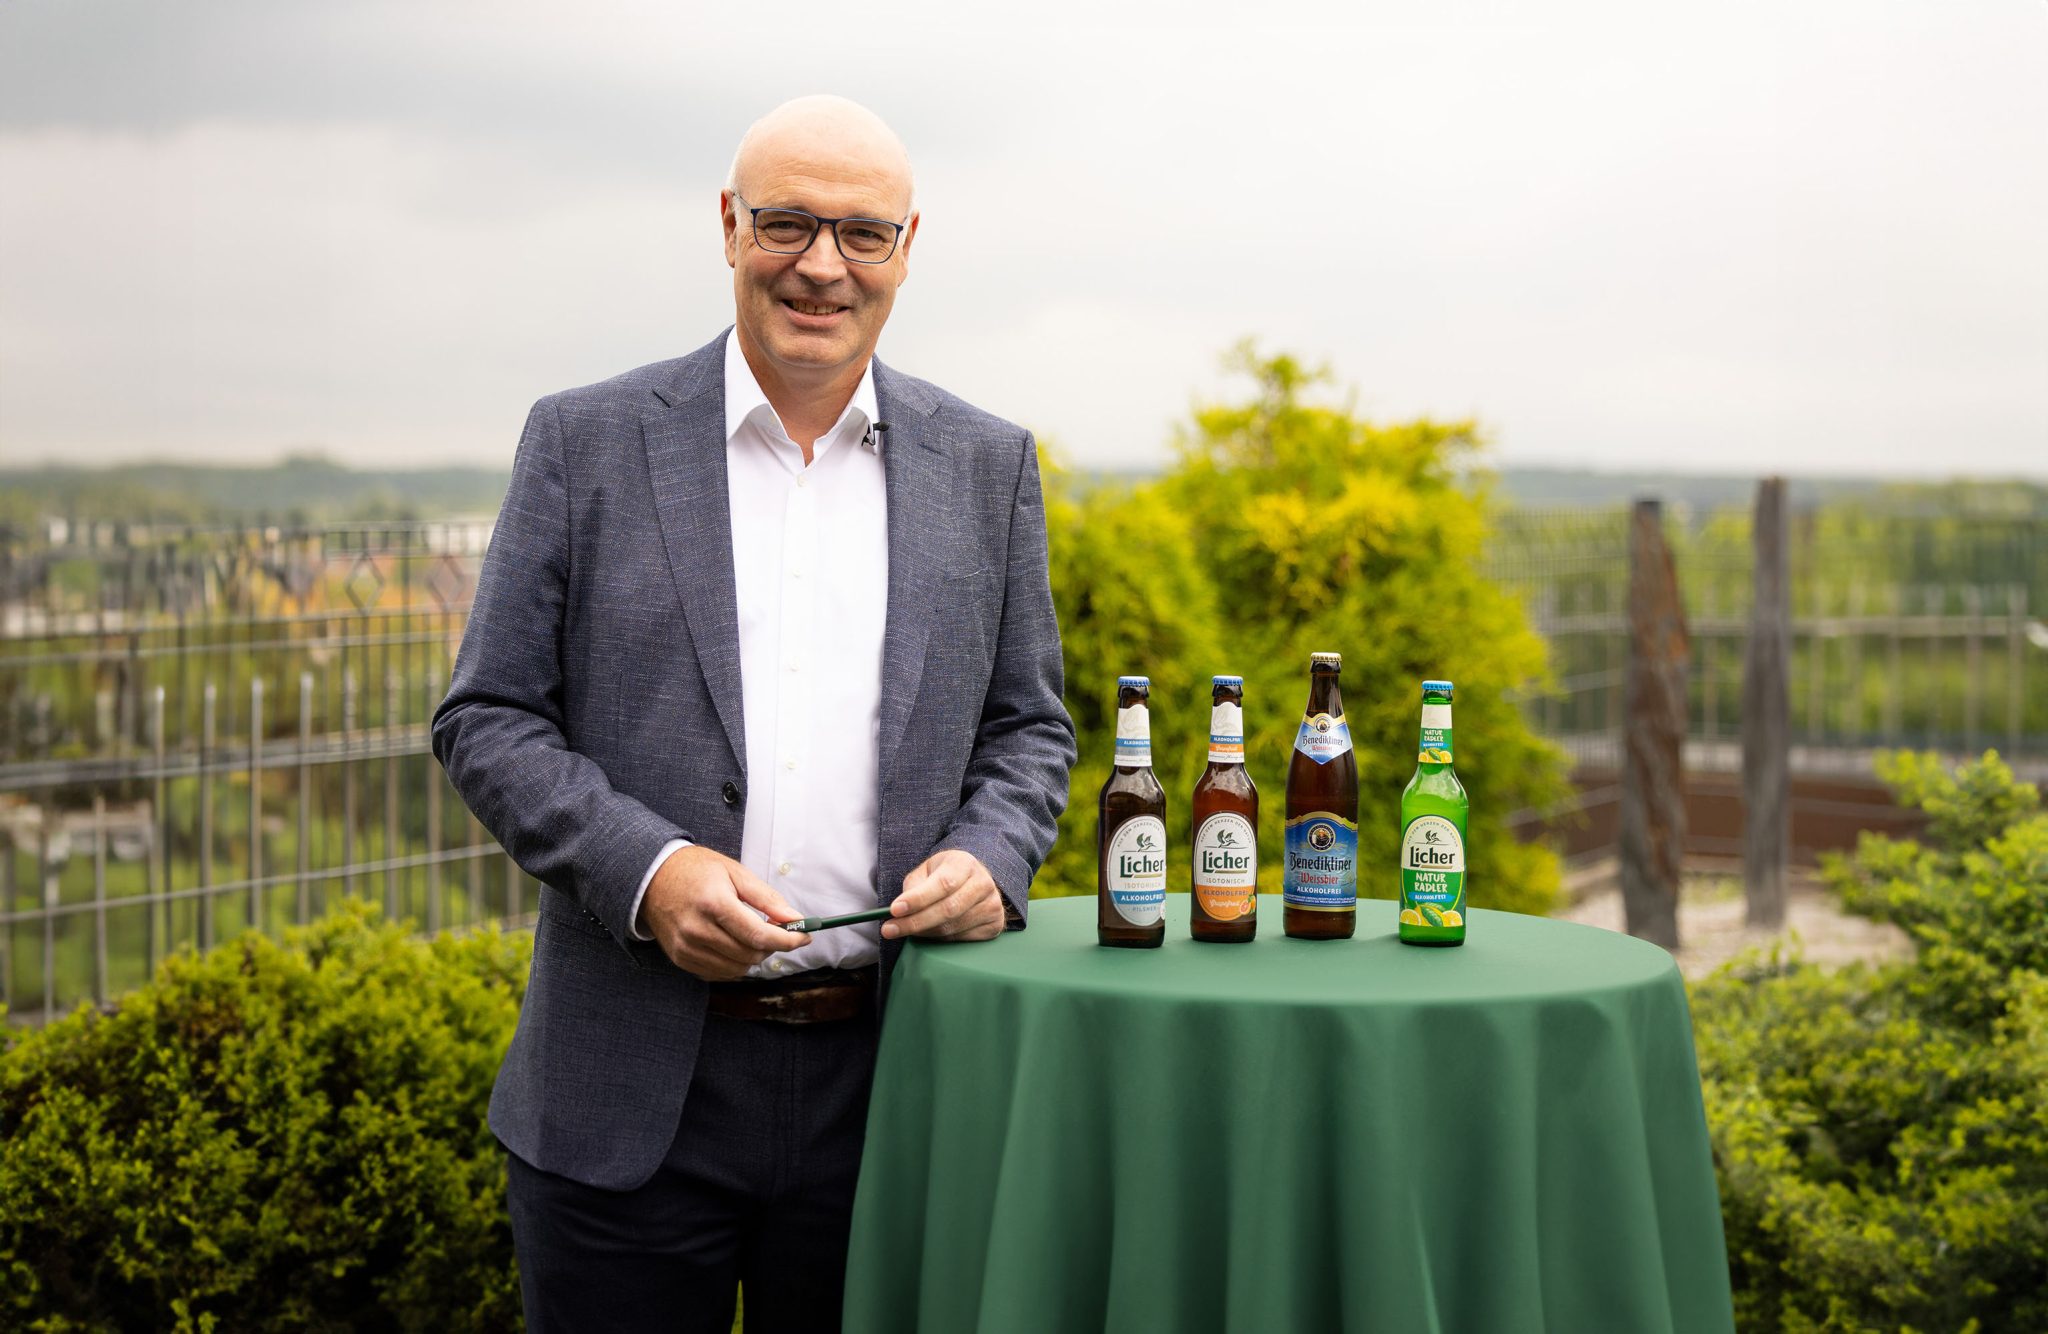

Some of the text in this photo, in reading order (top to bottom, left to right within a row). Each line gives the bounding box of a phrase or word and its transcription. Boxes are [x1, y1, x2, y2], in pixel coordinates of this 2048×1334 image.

[1302, 735, 1344, 747] Benediktiner
[1202, 850, 1250, 873] Licher
[1289, 851, 1352, 873] Benediktiner
[1409, 845, 1455, 868] Licher
[1120, 855, 1164, 878] Licher
[1299, 872, 1339, 885] Weissbier
[1415, 872, 1446, 883] NATUR
[1296, 885, 1342, 895] ALKOHOLFREI
[1414, 882, 1448, 893] RADLER
